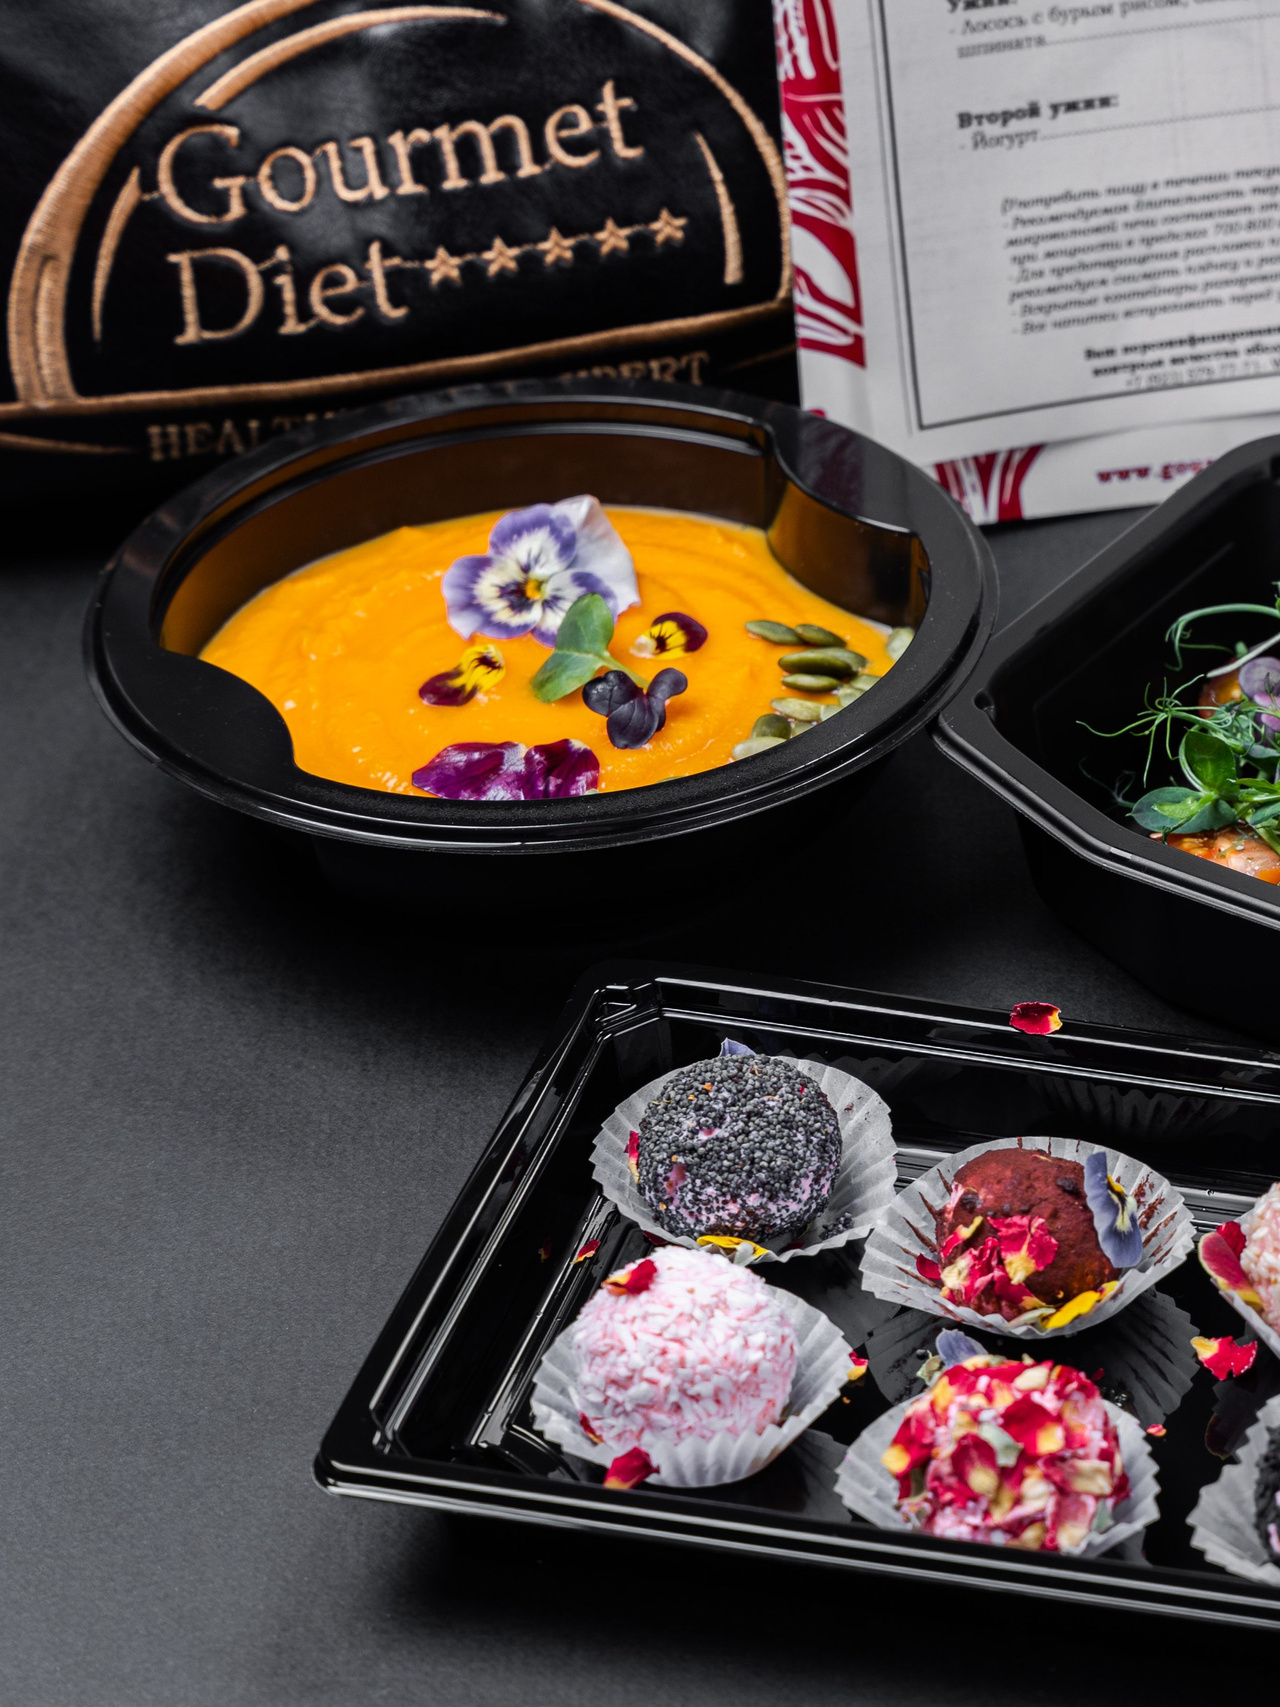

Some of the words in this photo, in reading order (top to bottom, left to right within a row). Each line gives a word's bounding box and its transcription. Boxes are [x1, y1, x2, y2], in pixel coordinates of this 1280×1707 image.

[957, 101, 1041, 129] Второй
[1049, 95, 1119, 120] ужин:
[972, 130, 1039, 150] Йогурт
[158, 80, 643, 224] Gourmet
[168, 241, 408, 346] Diet
